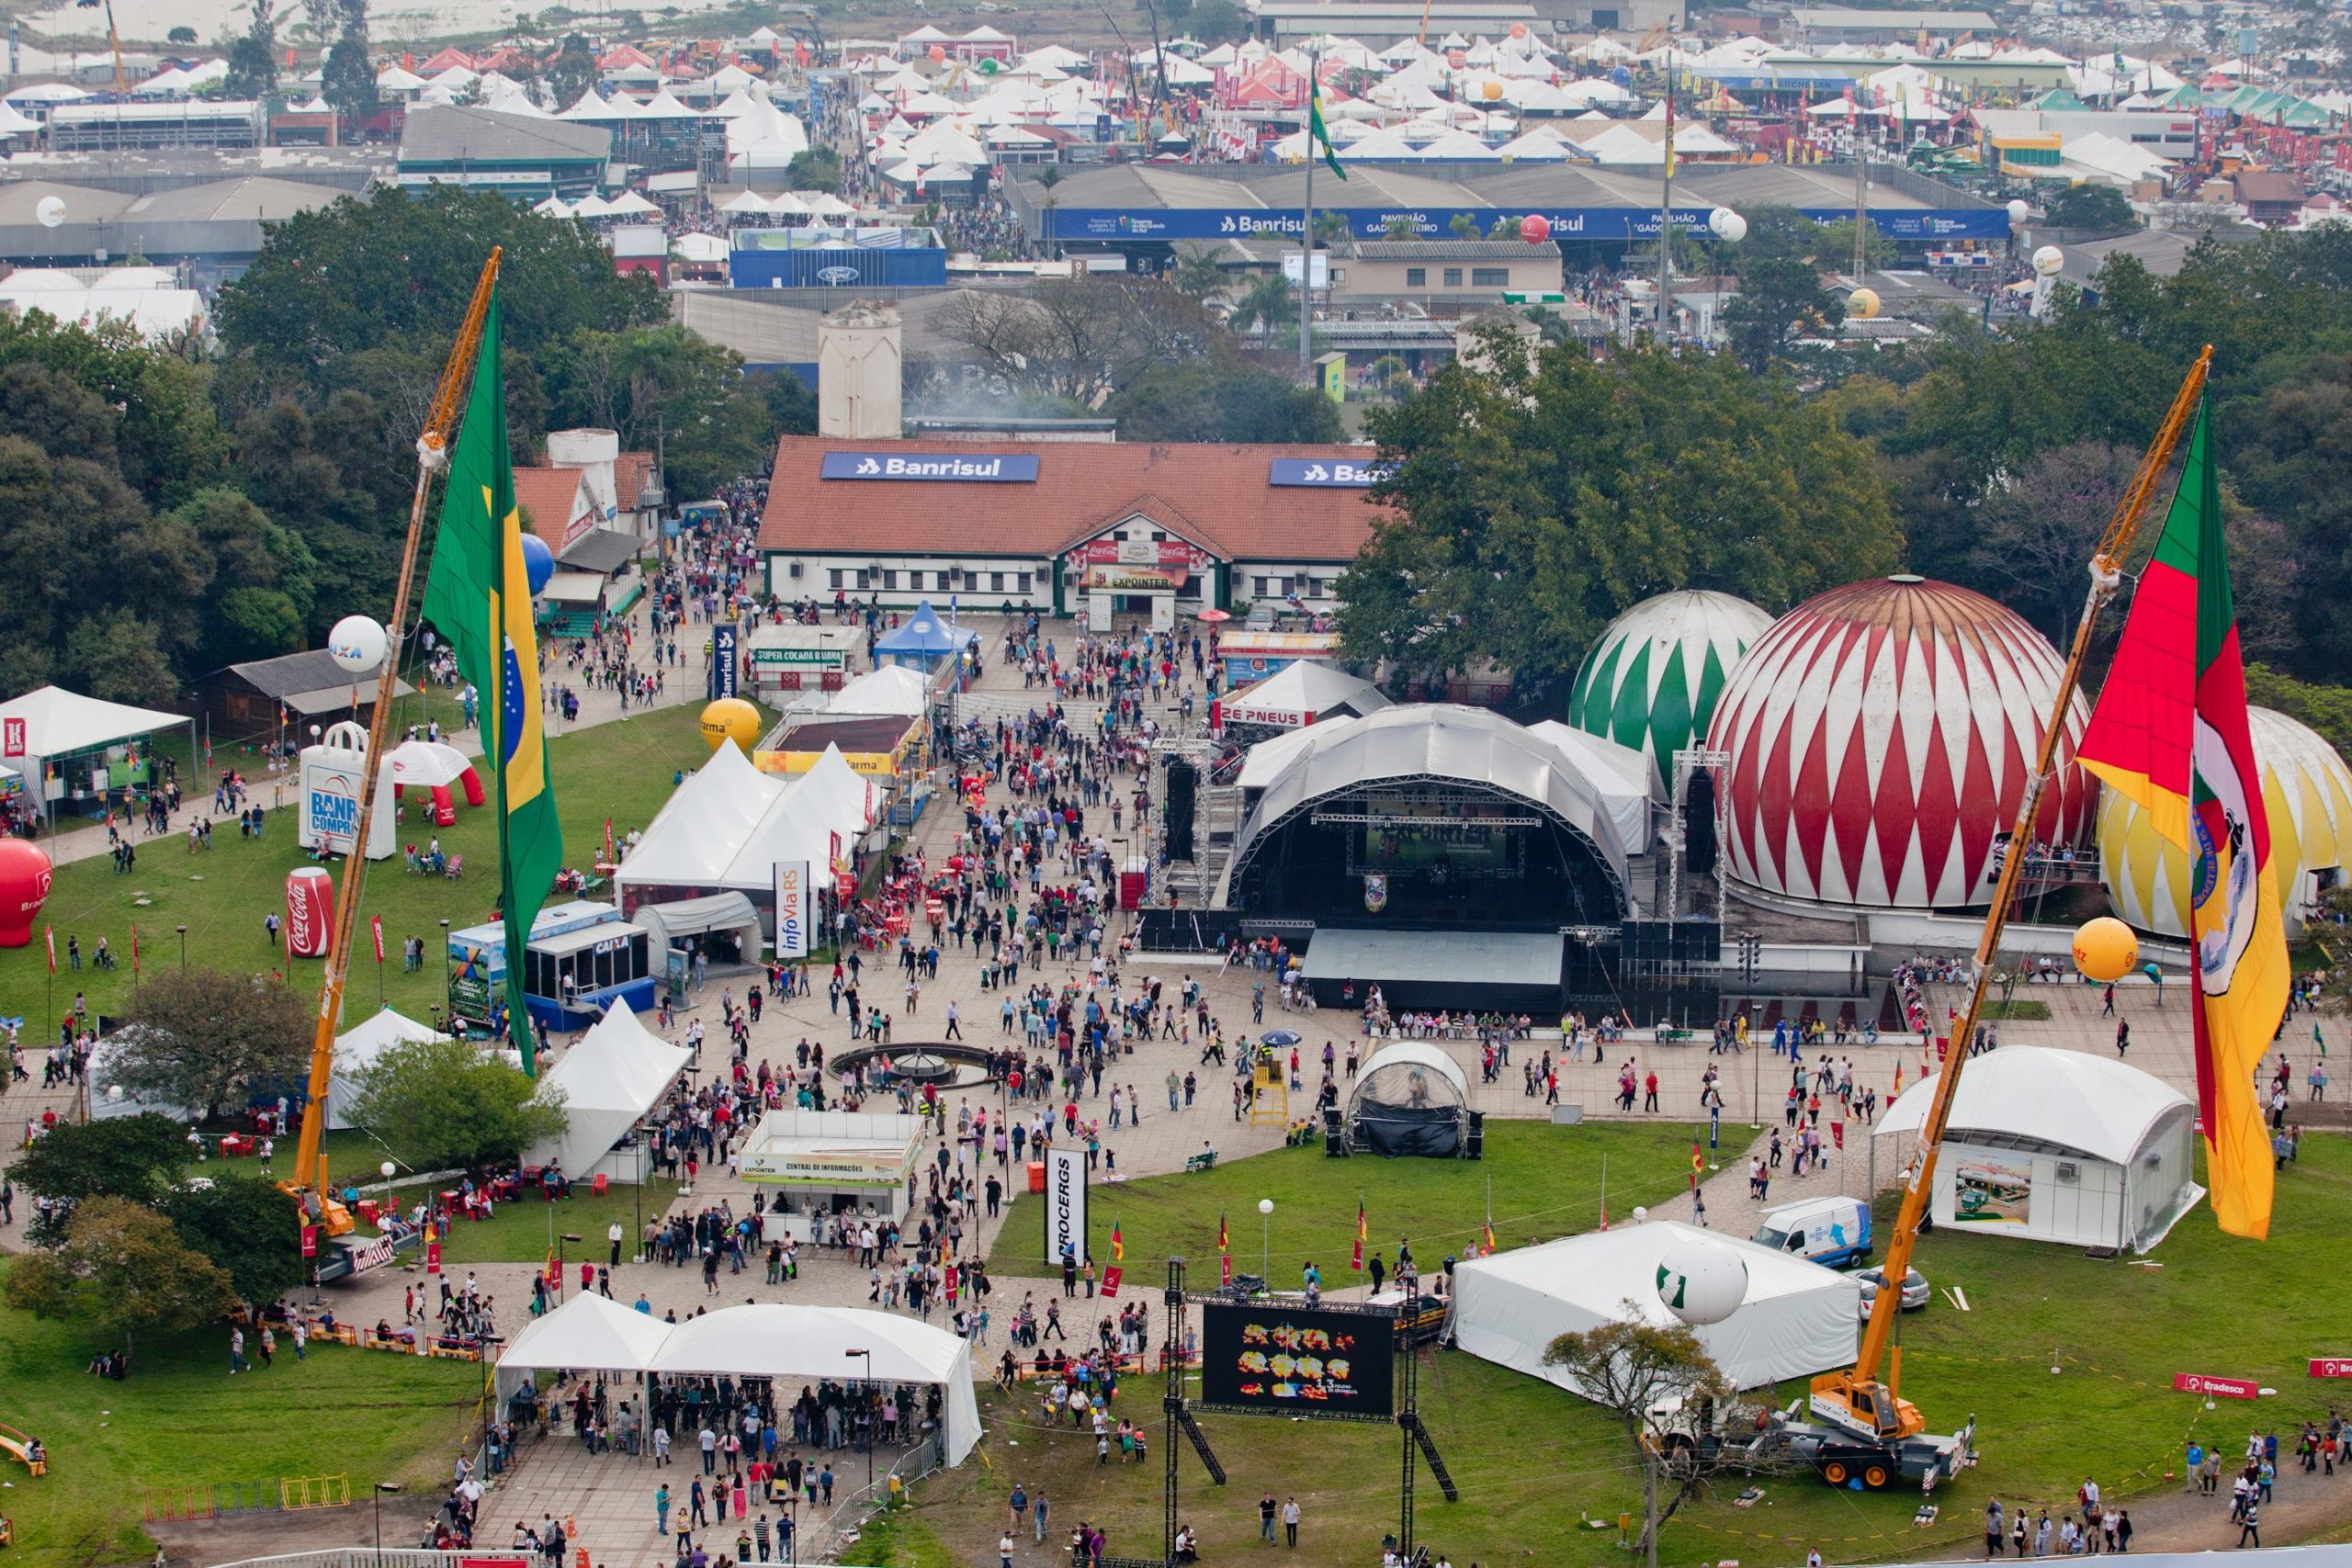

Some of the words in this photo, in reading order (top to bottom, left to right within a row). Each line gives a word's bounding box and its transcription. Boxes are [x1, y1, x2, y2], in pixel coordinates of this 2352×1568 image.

[1239, 216, 1306, 232] Banrisu
[1651, 213, 1696, 223] PAILHÃO
[825, 268, 852, 280] Ford
[885, 457, 1001, 477] Banrisul
[1113, 578, 1169, 589] EXPOINTER
[758, 650, 782, 660] SUPER
[720, 650, 732, 700] Banrisul
[1246, 710, 1298, 725] PNEUS
[783, 869, 798, 890] RS
[288, 879, 311, 953] Coca-Cola
[595, 935, 629, 954] CAIXA
[744, 1166, 776, 1174] EXPOINTER
[786, 1163, 811, 1171] CENTRAL
[820, 1163, 864, 1174] INFORMAÇÕES
[2203, 1381, 2245, 1394] Bradesco
